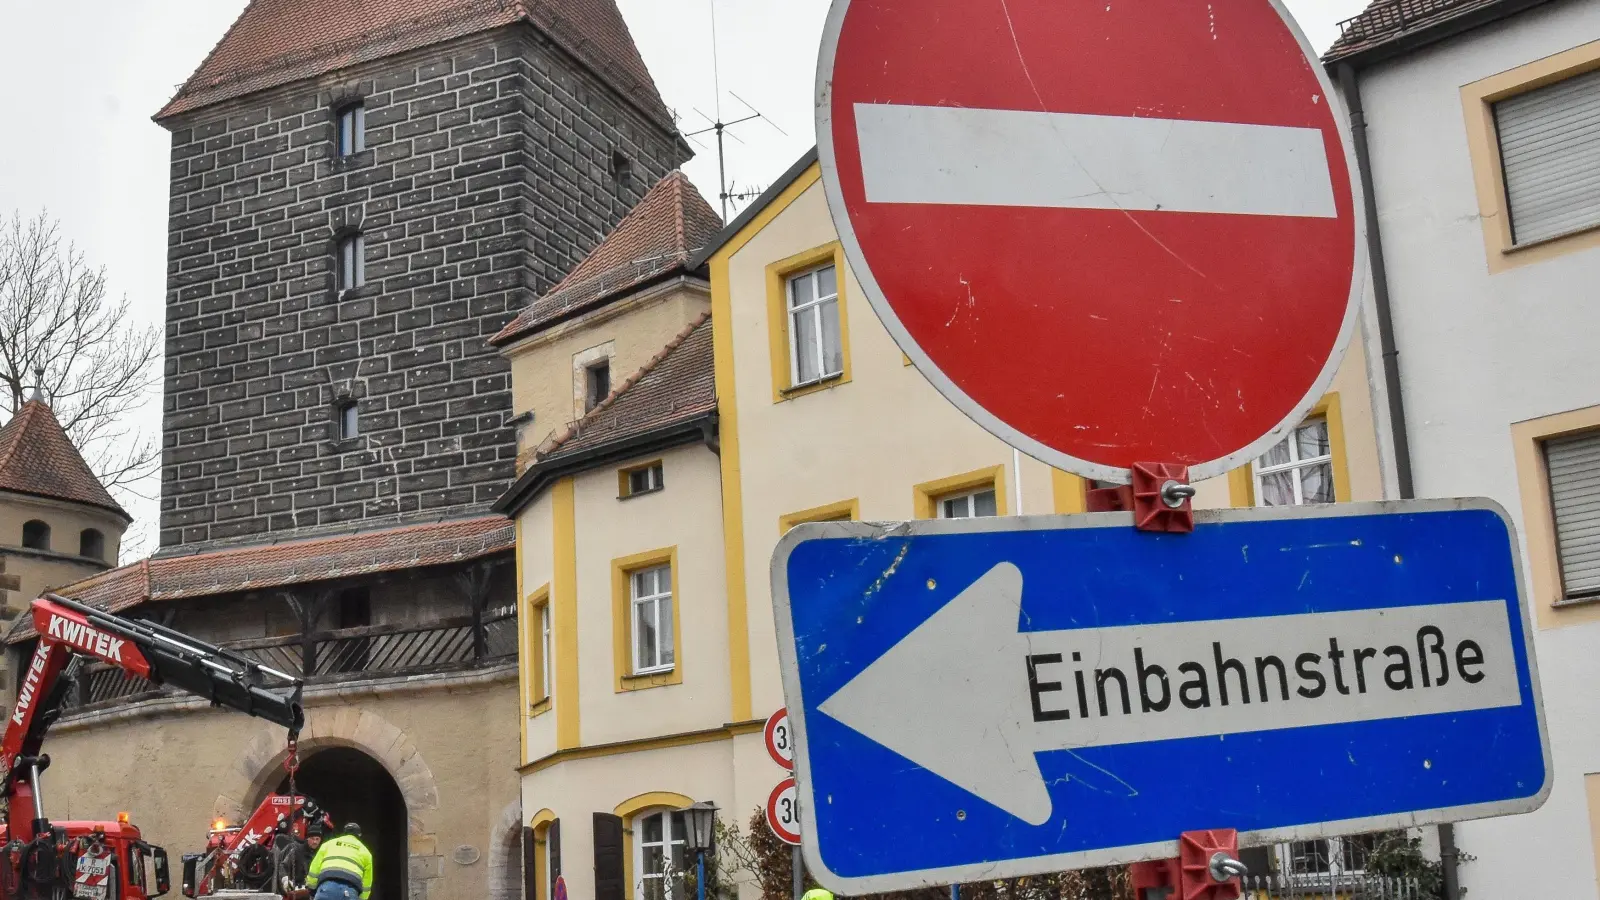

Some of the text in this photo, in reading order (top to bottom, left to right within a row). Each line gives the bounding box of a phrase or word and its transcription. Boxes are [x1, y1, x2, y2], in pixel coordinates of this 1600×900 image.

[48, 614, 124, 662] KWITEK
[1026, 625, 1486, 722] Einbahnstraße
[12, 640, 51, 726] KWITEK
